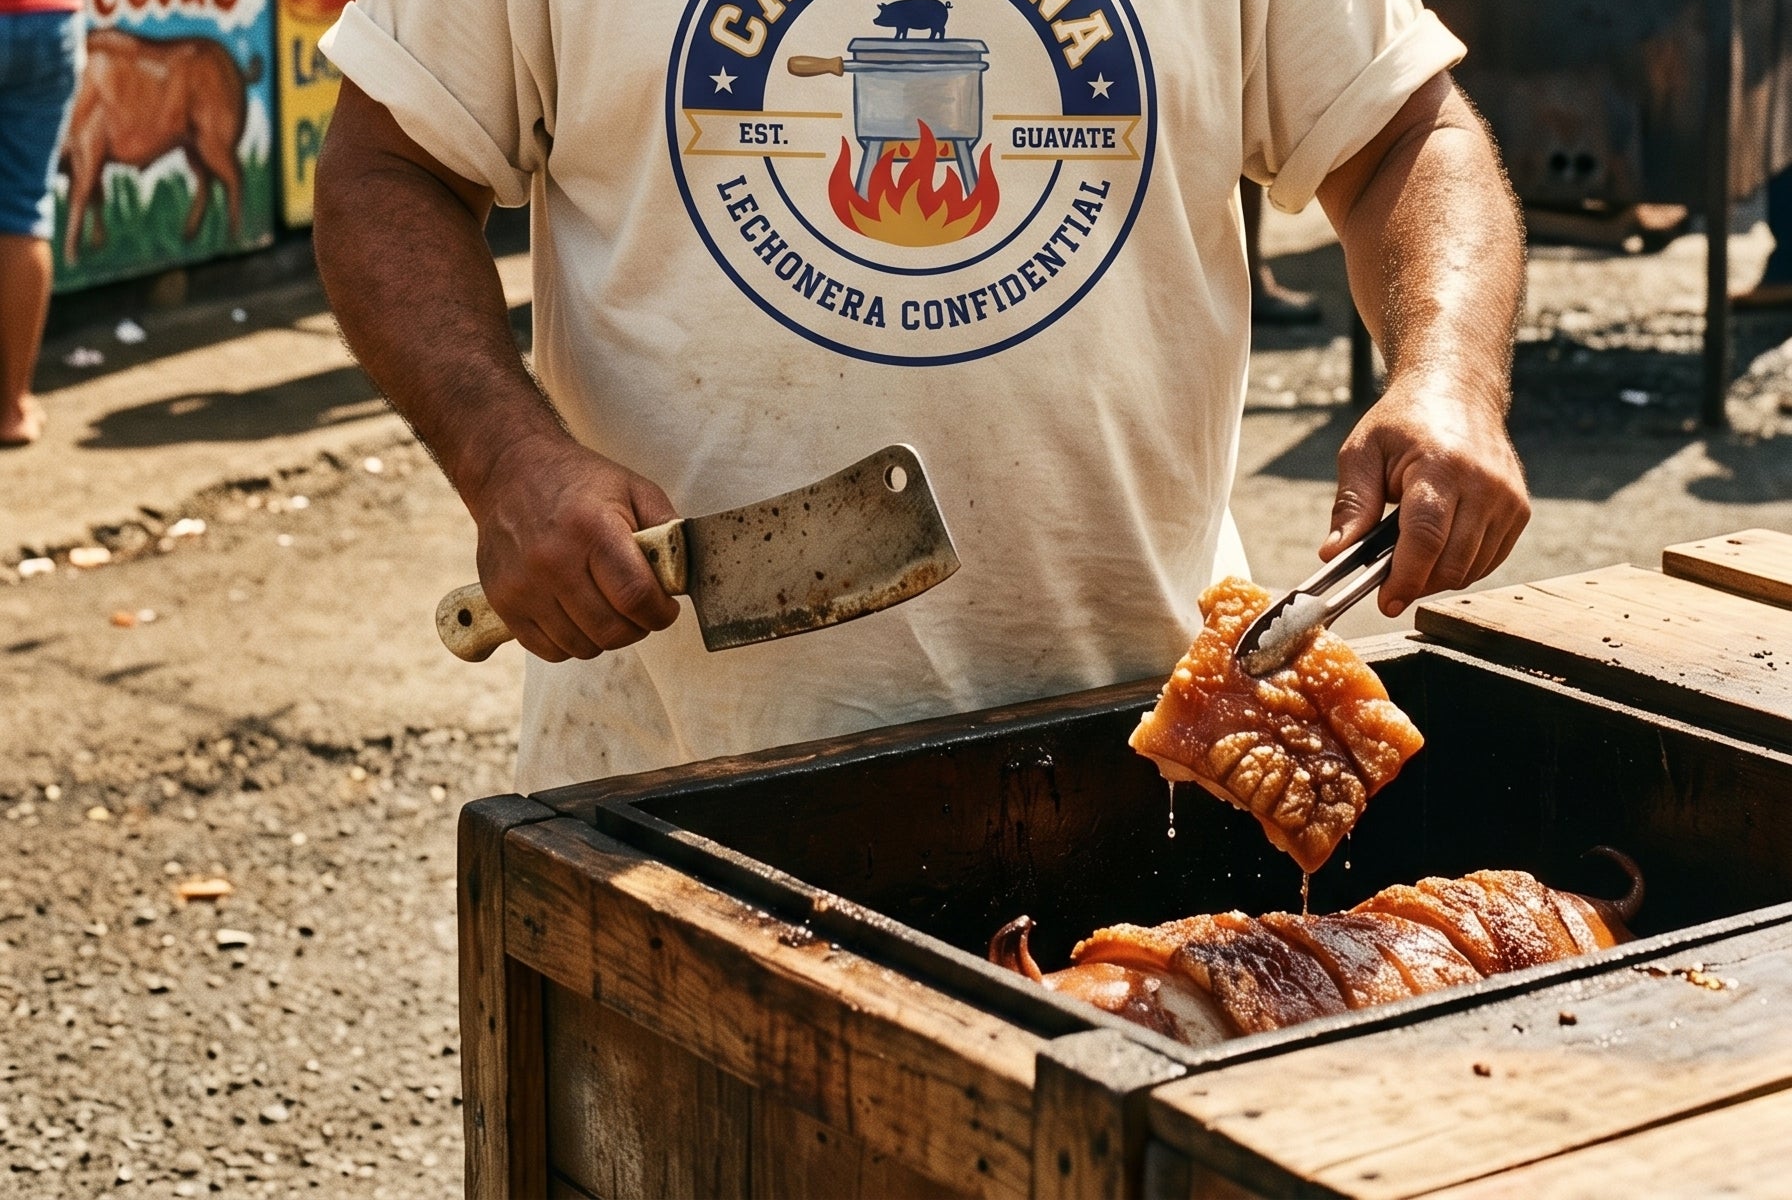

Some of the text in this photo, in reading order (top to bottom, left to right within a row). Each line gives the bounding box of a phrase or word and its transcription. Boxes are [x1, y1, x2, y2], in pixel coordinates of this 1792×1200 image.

[738, 122, 789, 146] EST.
[1011, 126, 1116, 150] GUAVATE
[716, 174, 1112, 331] LECHONERA CONFIDENTIAL
